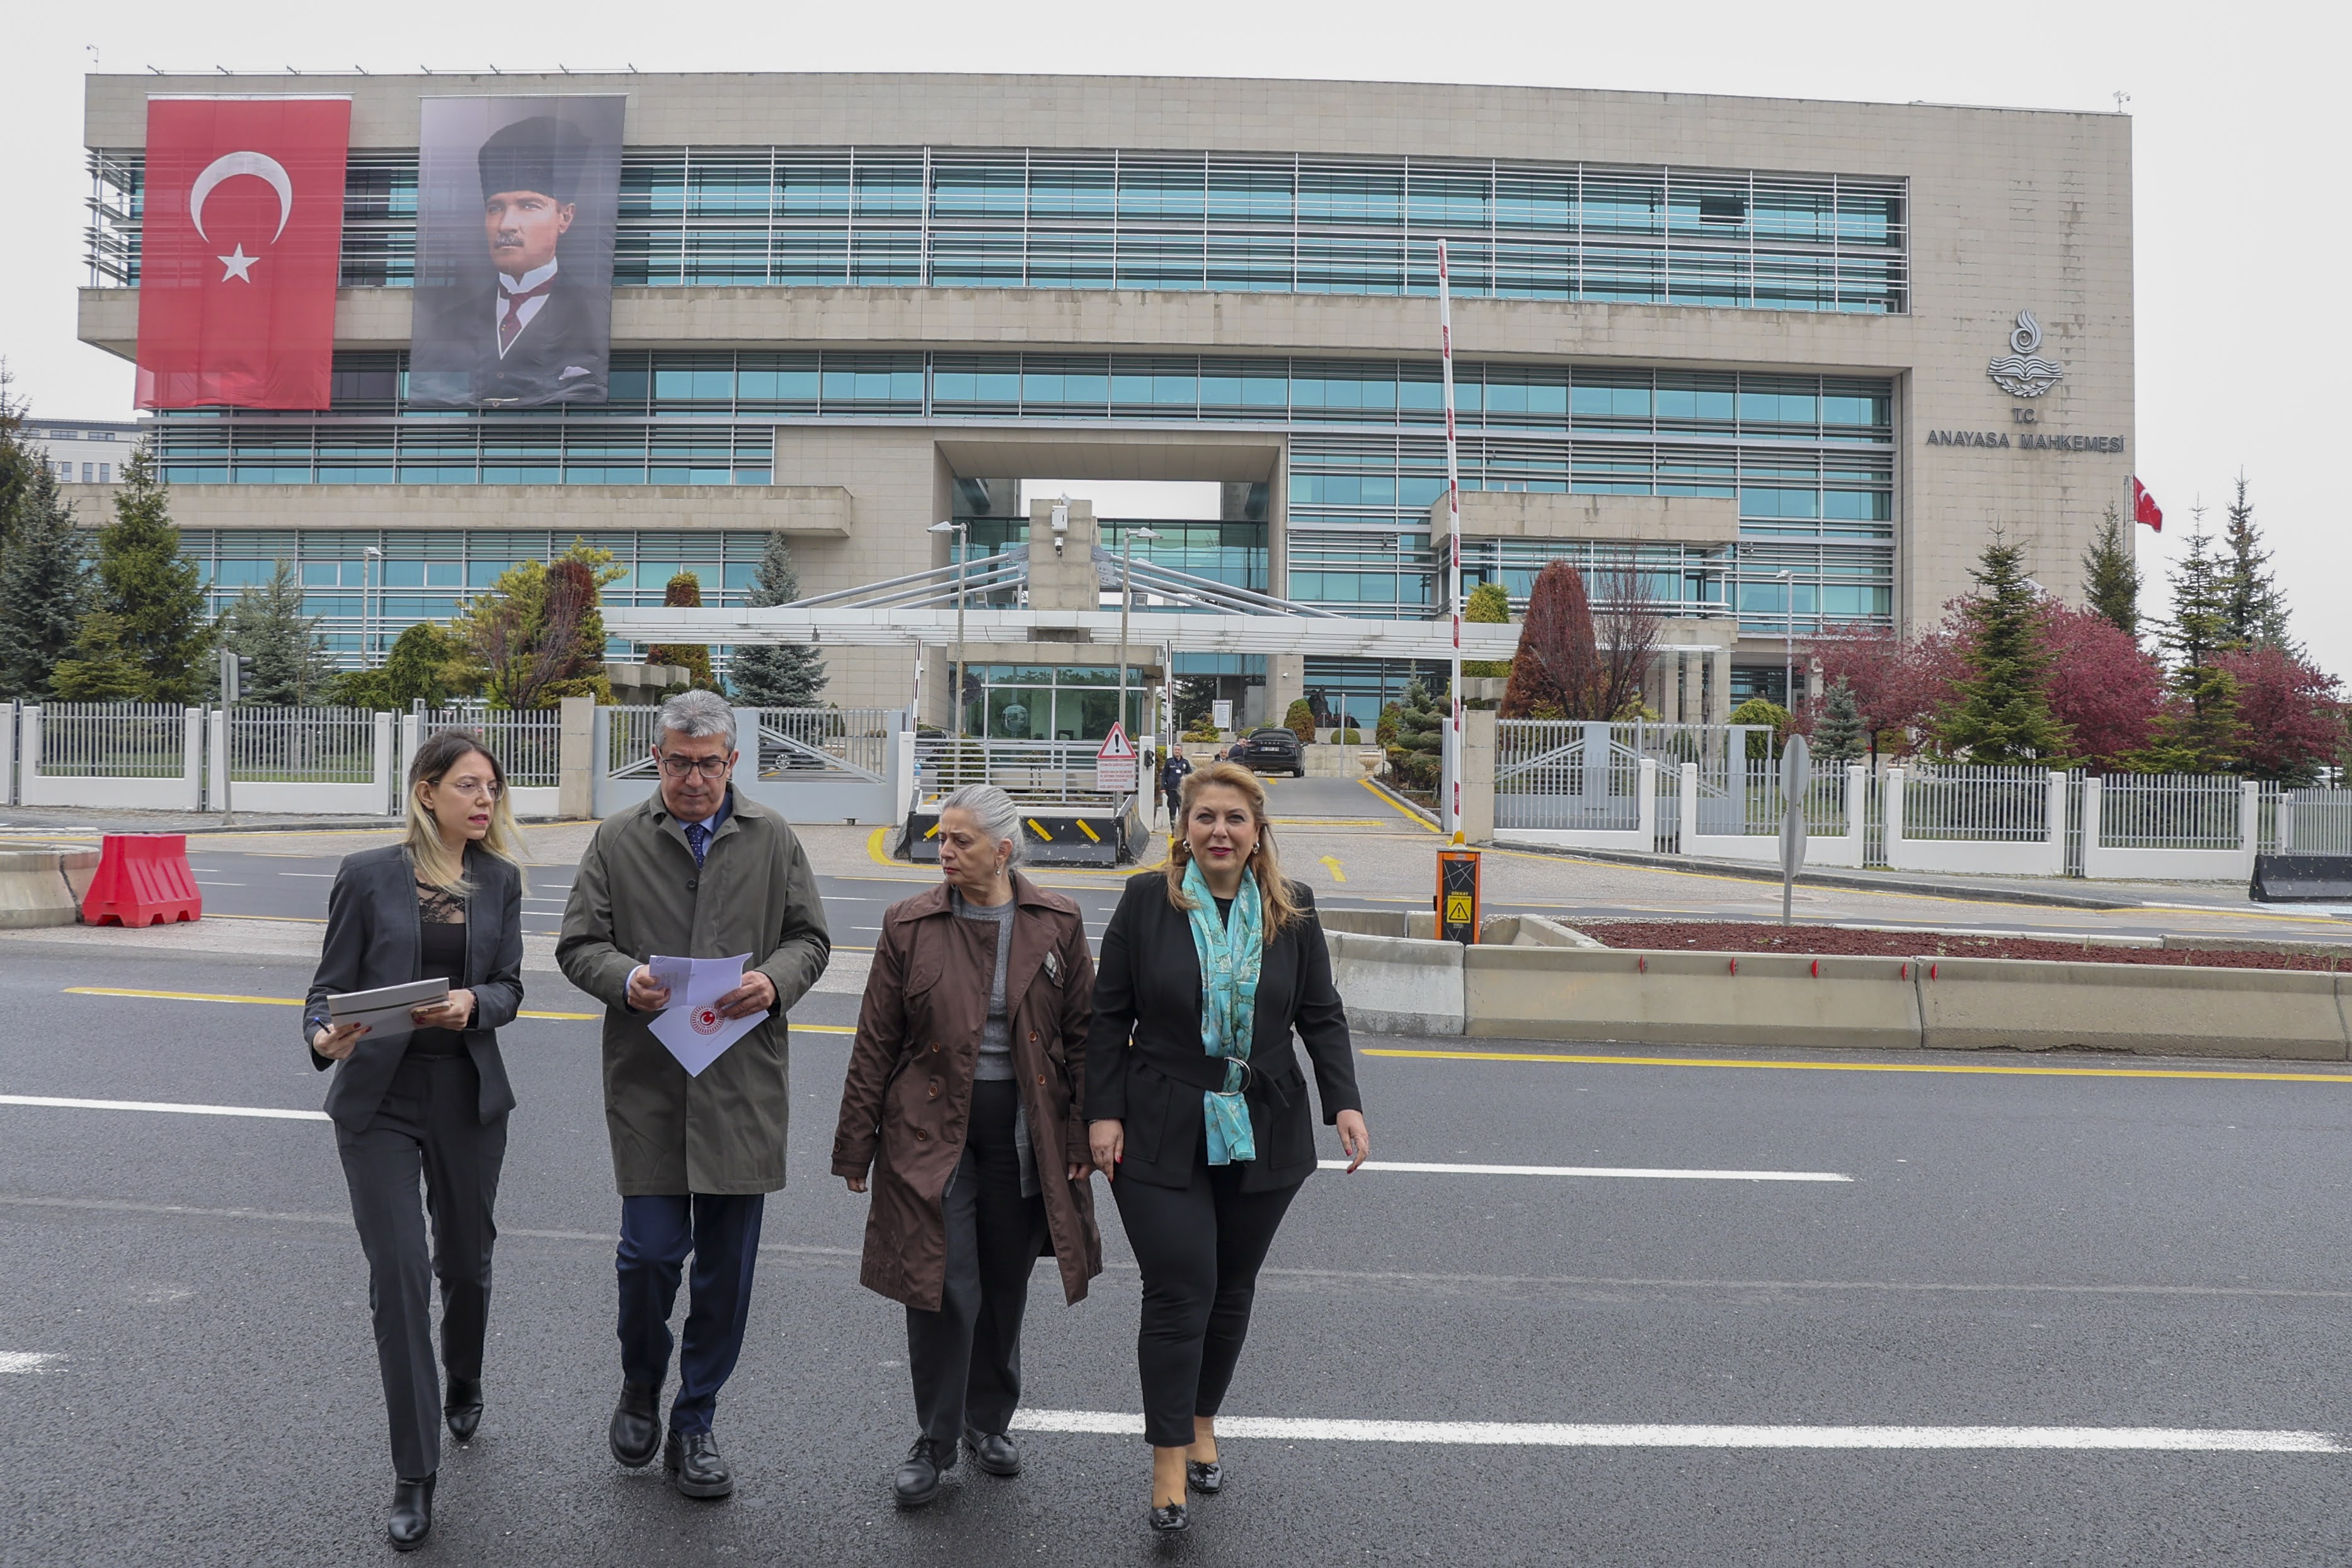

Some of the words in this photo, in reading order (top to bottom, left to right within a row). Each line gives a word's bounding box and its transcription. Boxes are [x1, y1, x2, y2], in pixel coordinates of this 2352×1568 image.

[2012, 408, 2038, 424] T.C.
[1926, 430, 2011, 449] ANAYASA
[2021, 433, 2125, 452] MAHKEMESİ
